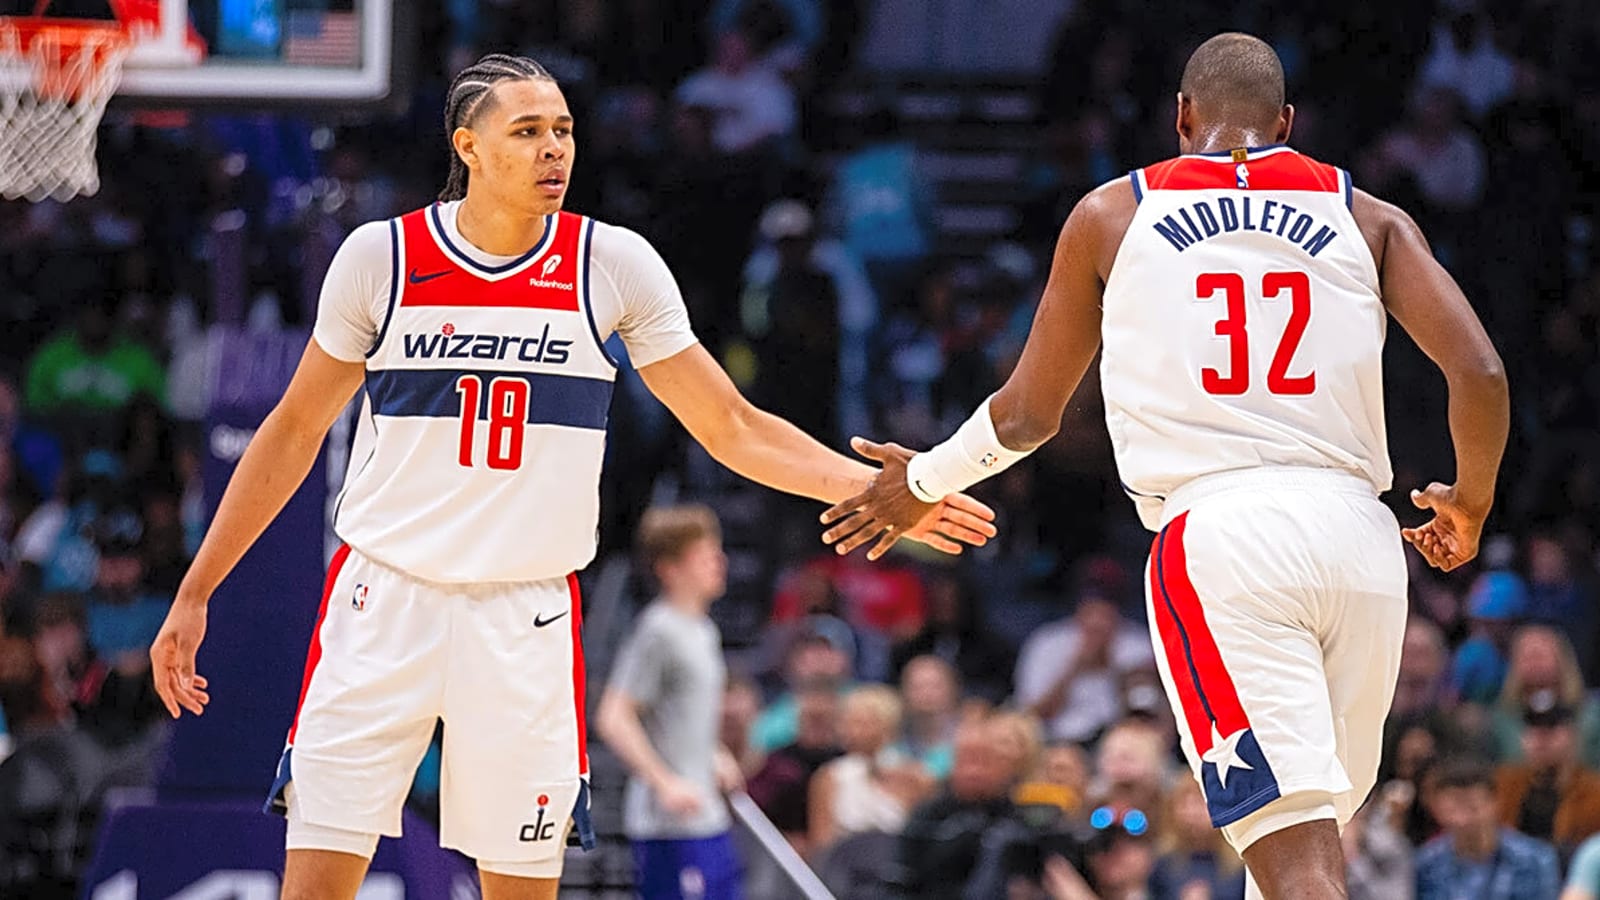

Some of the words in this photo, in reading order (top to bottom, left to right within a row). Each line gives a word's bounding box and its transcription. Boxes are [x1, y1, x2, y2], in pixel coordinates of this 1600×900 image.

[1152, 196, 1338, 258] MIDDLETON
[529, 278, 573, 291] Robinhood
[403, 322, 574, 364] wizards
[1195, 271, 1316, 395] 32
[456, 374, 531, 471] 18
